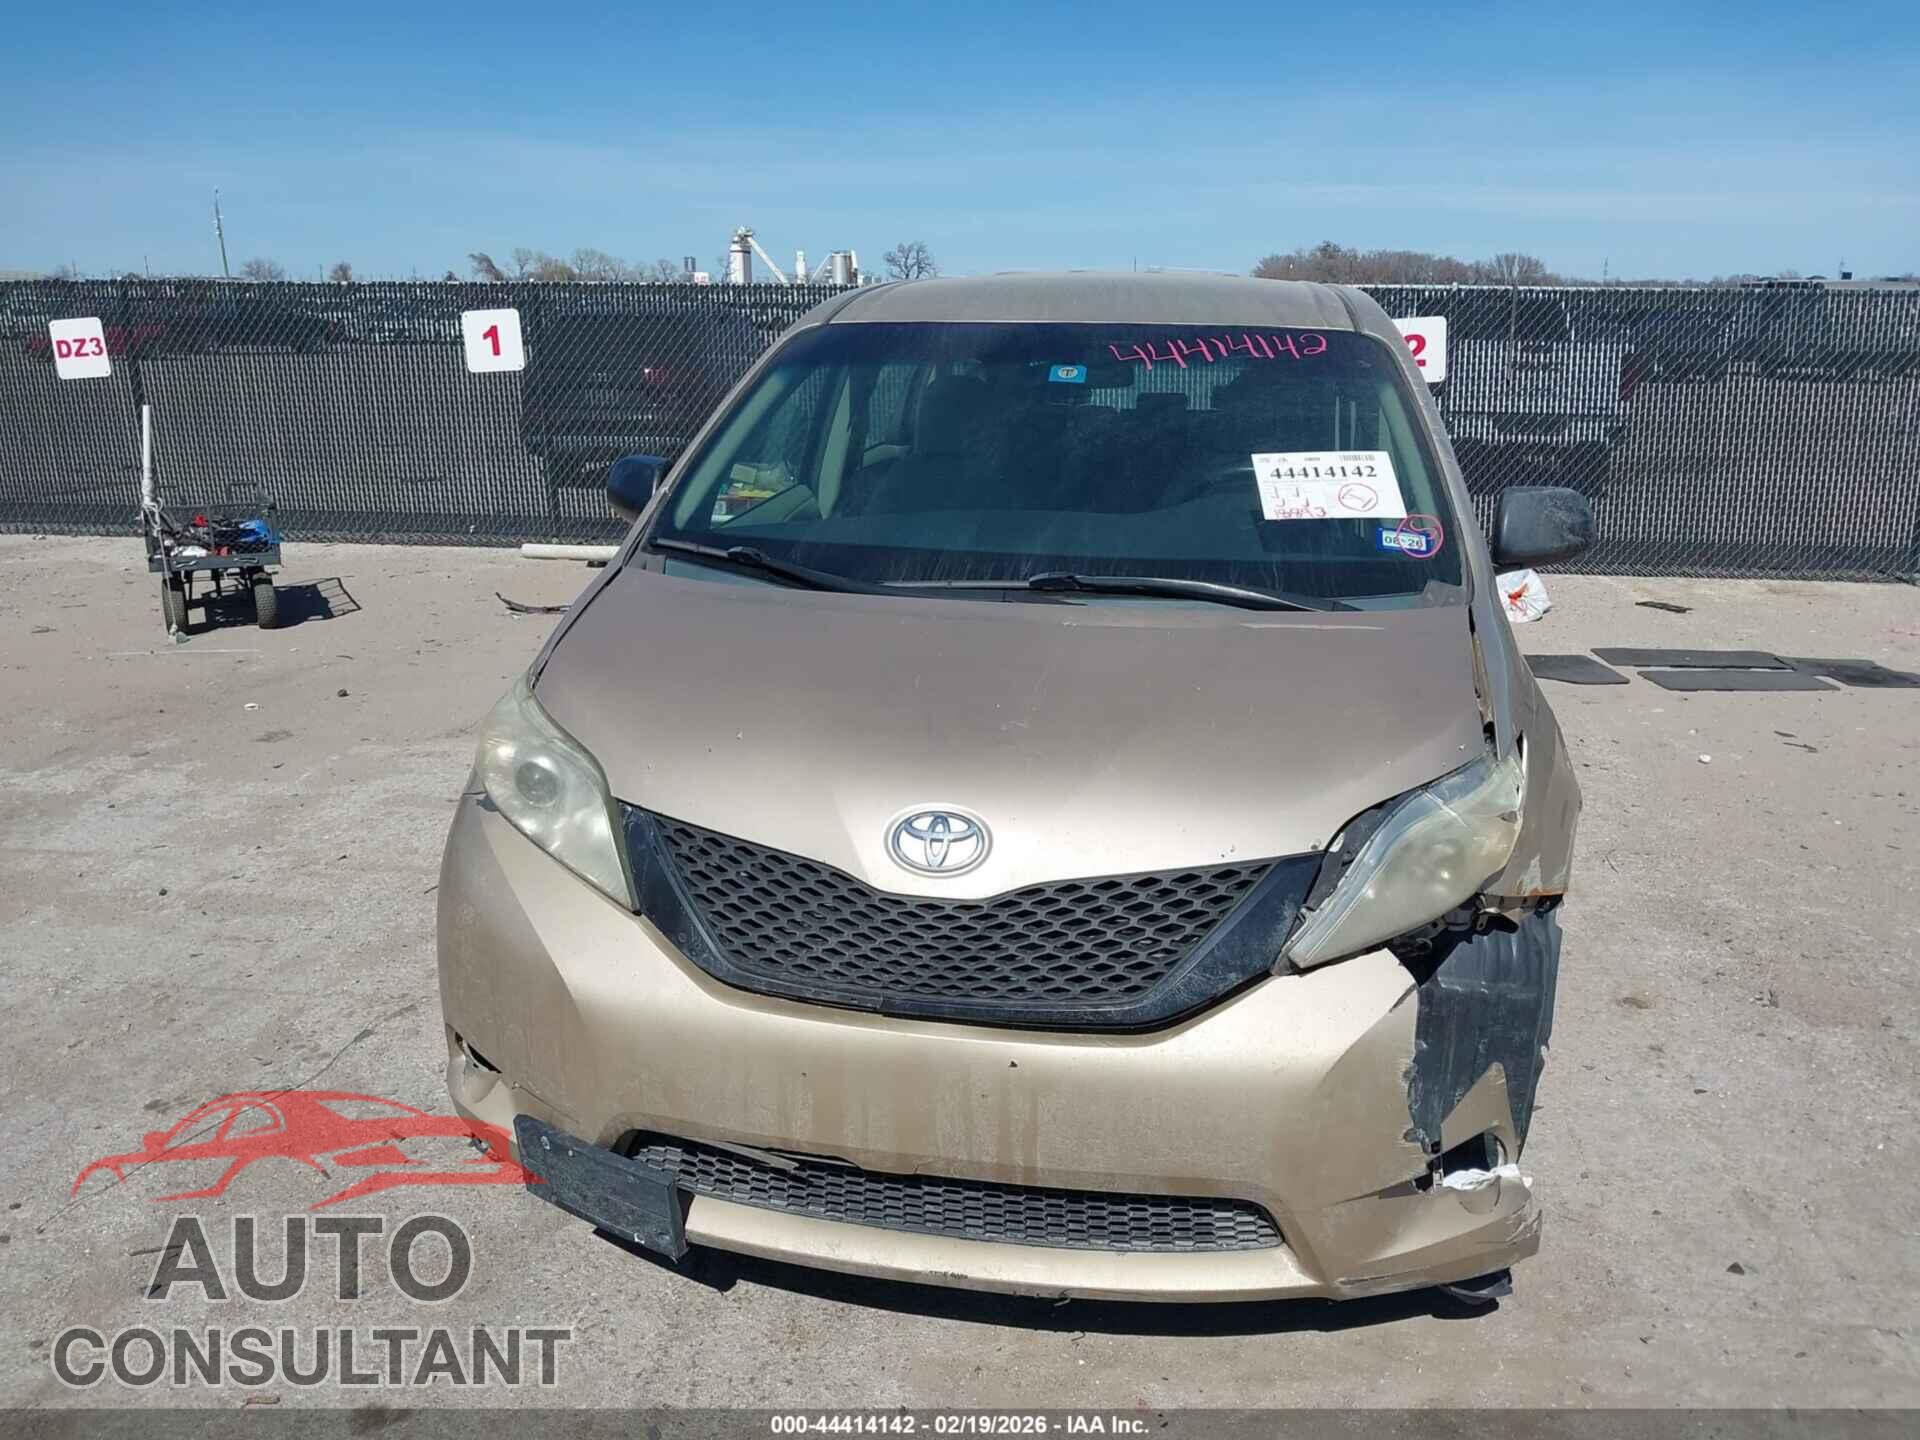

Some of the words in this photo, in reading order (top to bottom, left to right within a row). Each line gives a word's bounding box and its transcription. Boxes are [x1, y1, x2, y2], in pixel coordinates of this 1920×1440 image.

[55, 337, 104, 359] DZ3
[482, 325, 500, 356] 1
[1108, 333, 1328, 370] 44414142
[1404, 334, 1426, 367] 2
[1269, 464, 1377, 480] 44414142
